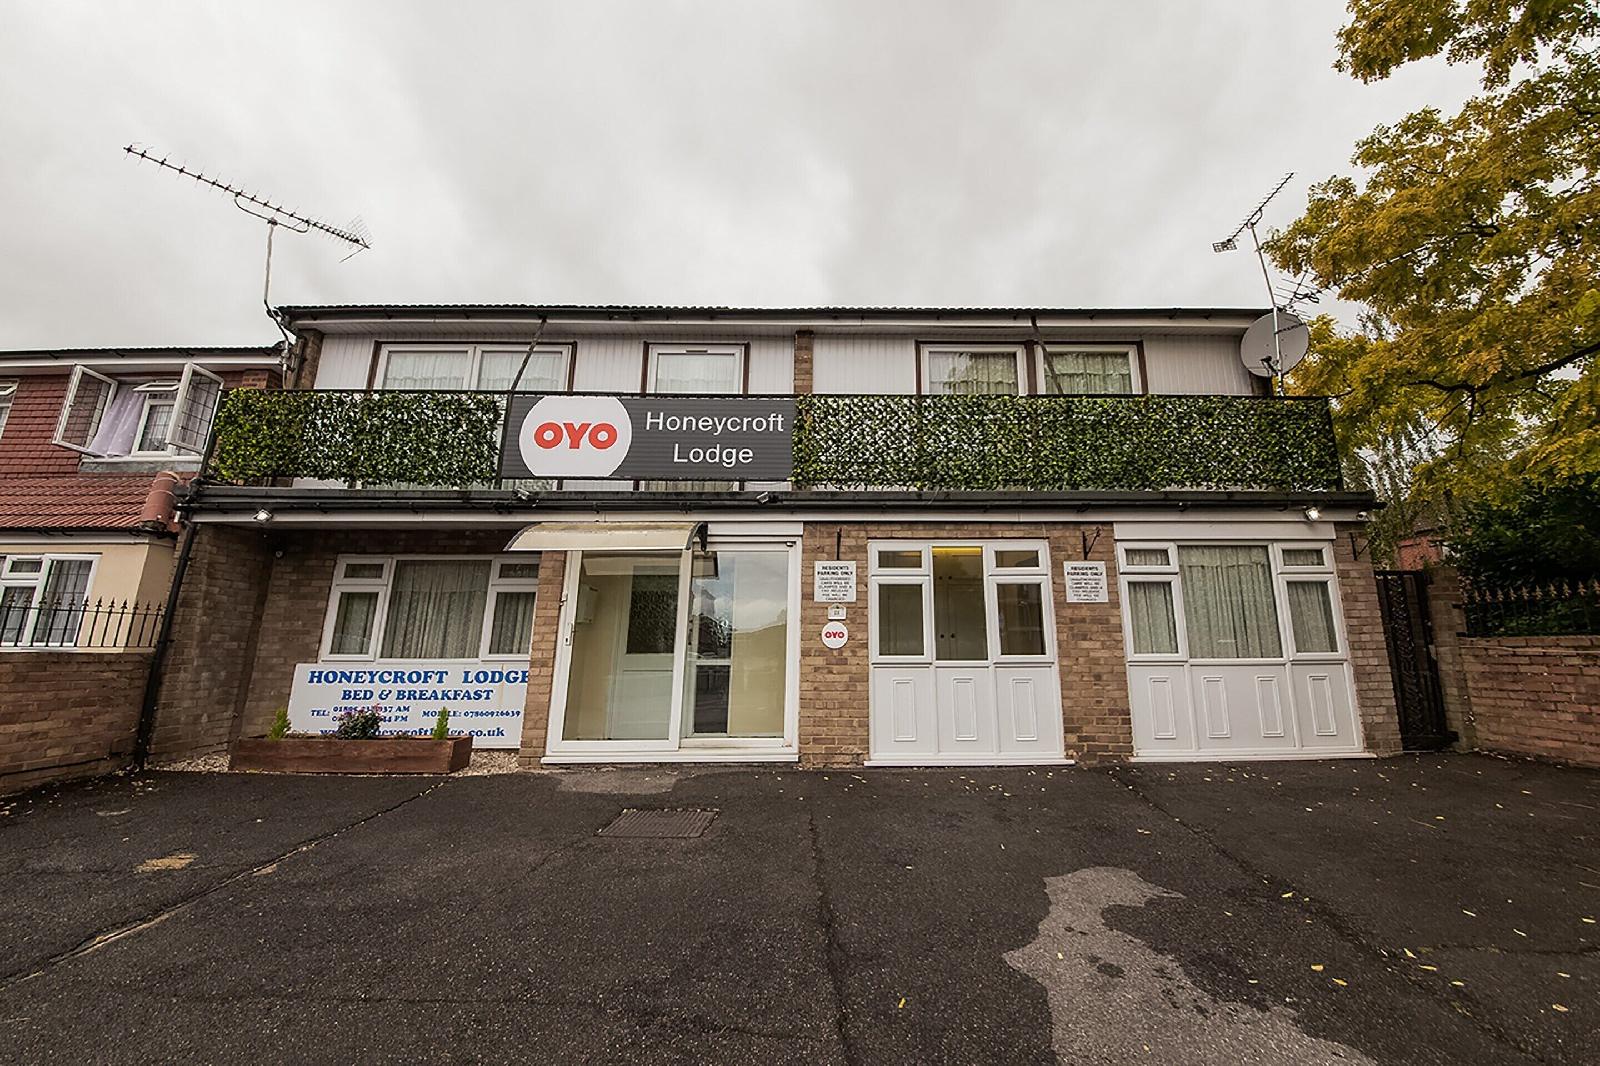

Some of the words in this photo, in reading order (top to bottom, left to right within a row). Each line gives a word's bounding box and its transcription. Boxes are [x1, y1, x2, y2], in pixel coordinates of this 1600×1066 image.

[645, 411, 785, 436] Honeycroft
[533, 422, 618, 450] OYO
[673, 443, 754, 468] Lodge
[824, 631, 845, 639] OYO
[307, 670, 449, 684] HONEYCROFT
[461, 670, 529, 684] LODGE
[341, 689, 374, 701] BED
[378, 689, 393, 701] &
[395, 689, 494, 701] BREAKFAST
[311, 709, 330, 717] TEL:
[395, 705, 410, 713] AM
